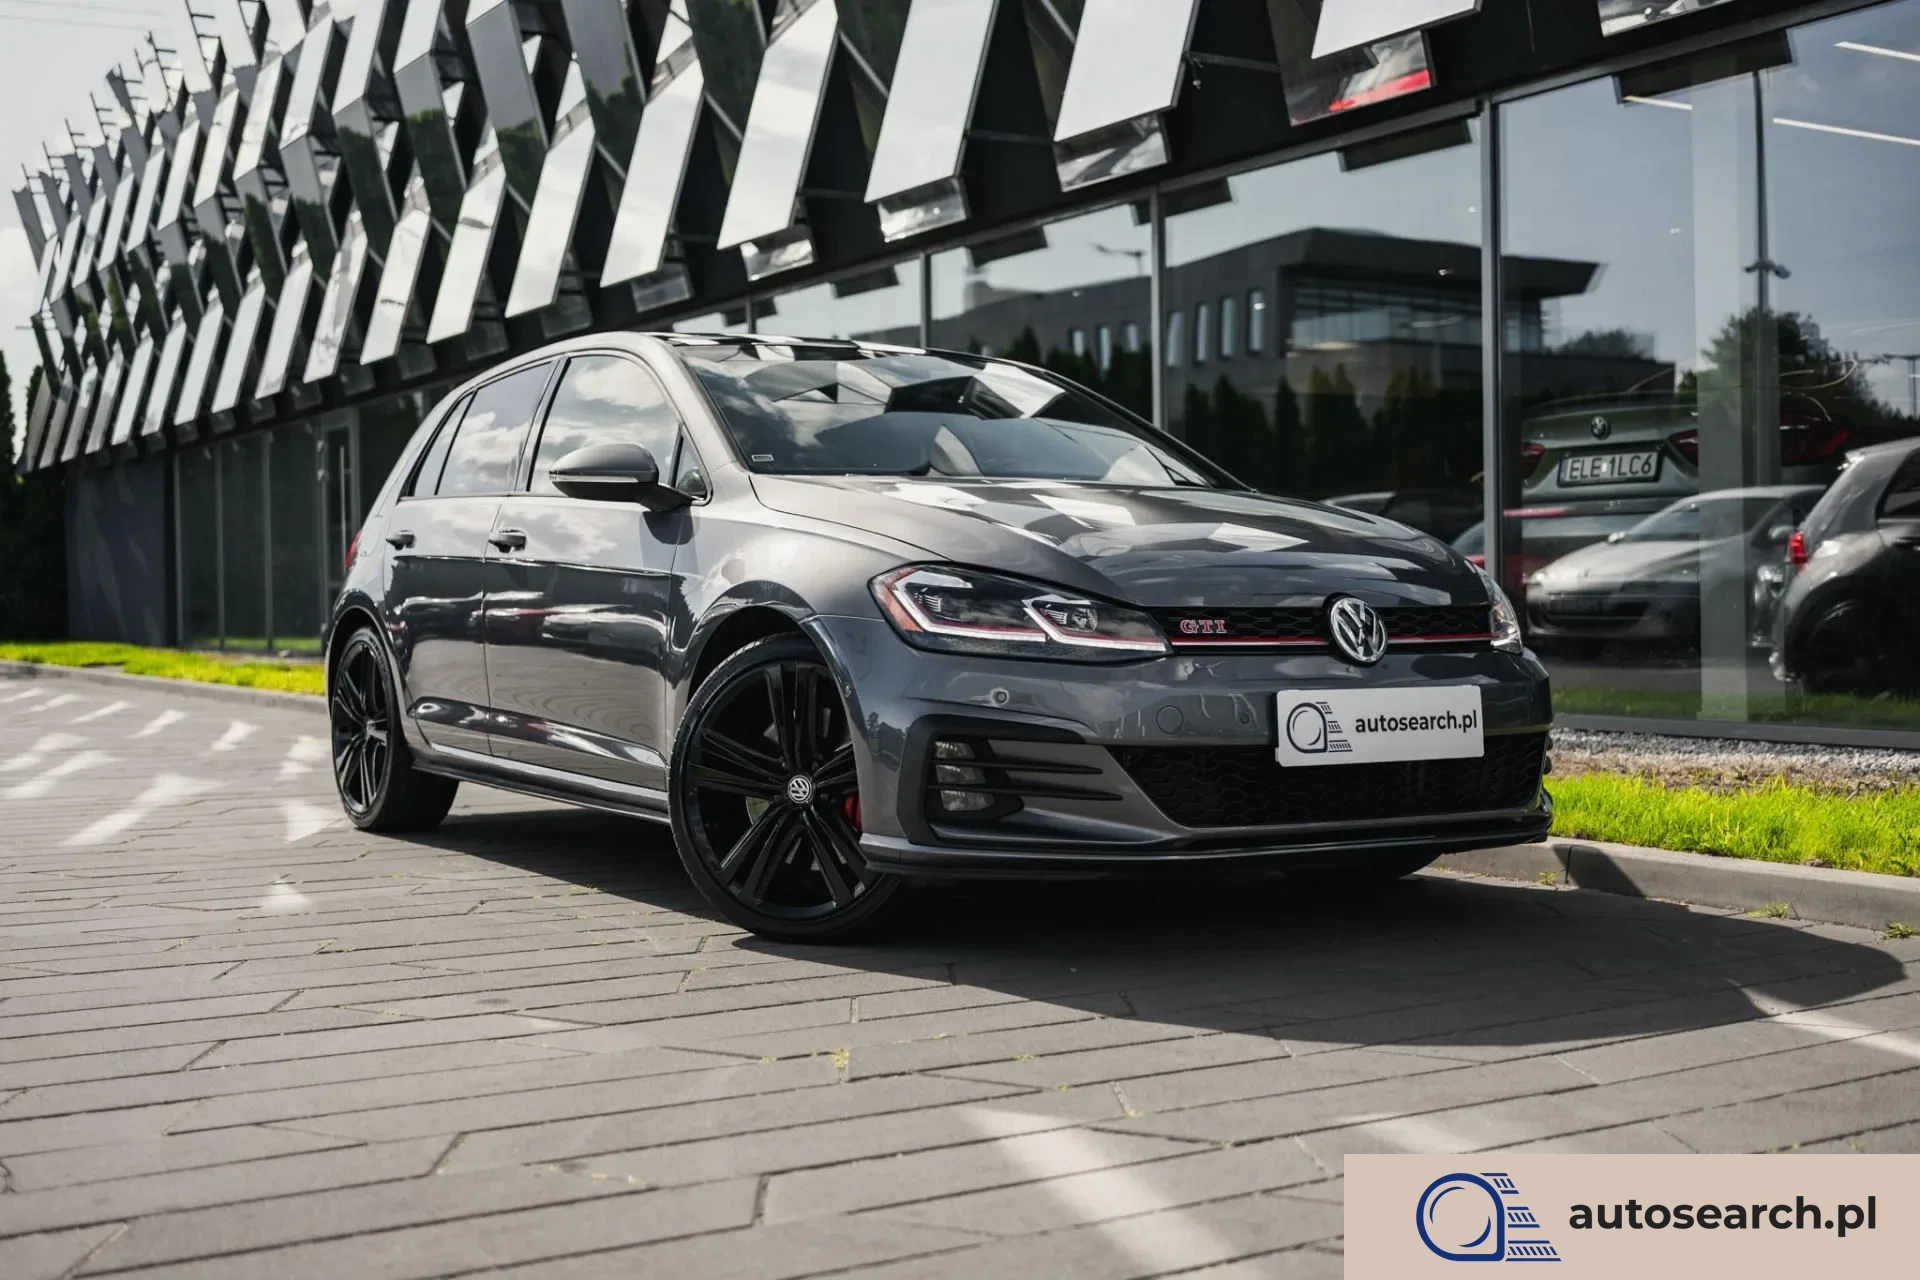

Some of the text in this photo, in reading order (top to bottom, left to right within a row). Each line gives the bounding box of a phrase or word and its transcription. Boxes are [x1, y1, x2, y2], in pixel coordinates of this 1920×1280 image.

[1570, 454, 1652, 479] ELE 1LC6
[1180, 619, 1227, 634] GTI
[1355, 709, 1477, 734] autosearch.pl
